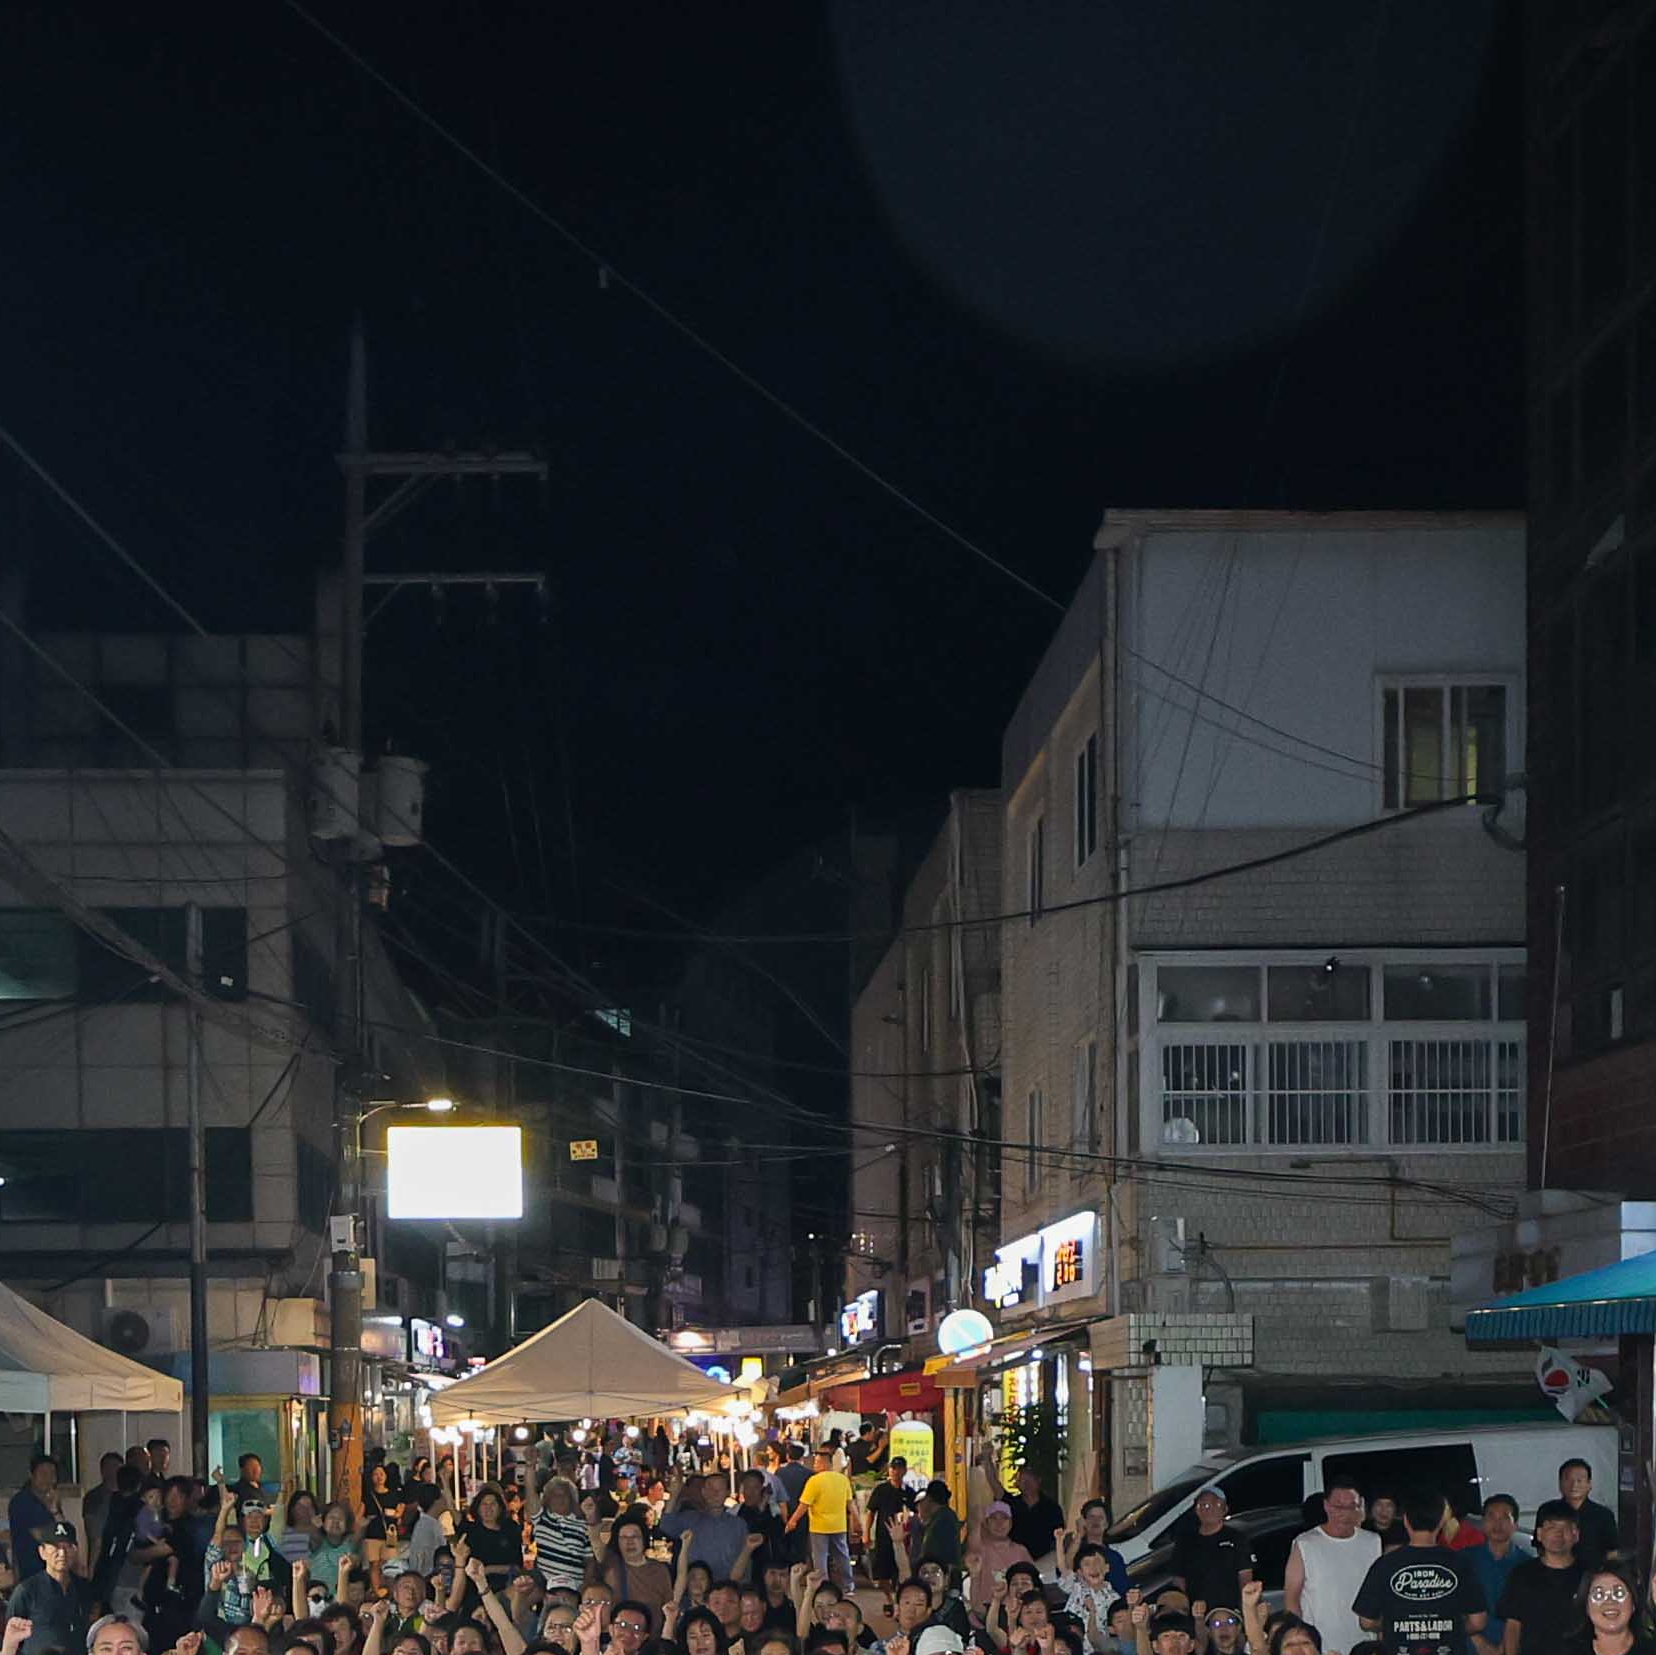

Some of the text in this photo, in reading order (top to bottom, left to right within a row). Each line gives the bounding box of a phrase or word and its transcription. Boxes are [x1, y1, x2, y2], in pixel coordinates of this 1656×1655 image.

[55, 1524, 67, 1536] A
[1414, 1570, 1434, 1578] IRON
[1395, 1572, 1454, 1591] Paradise
